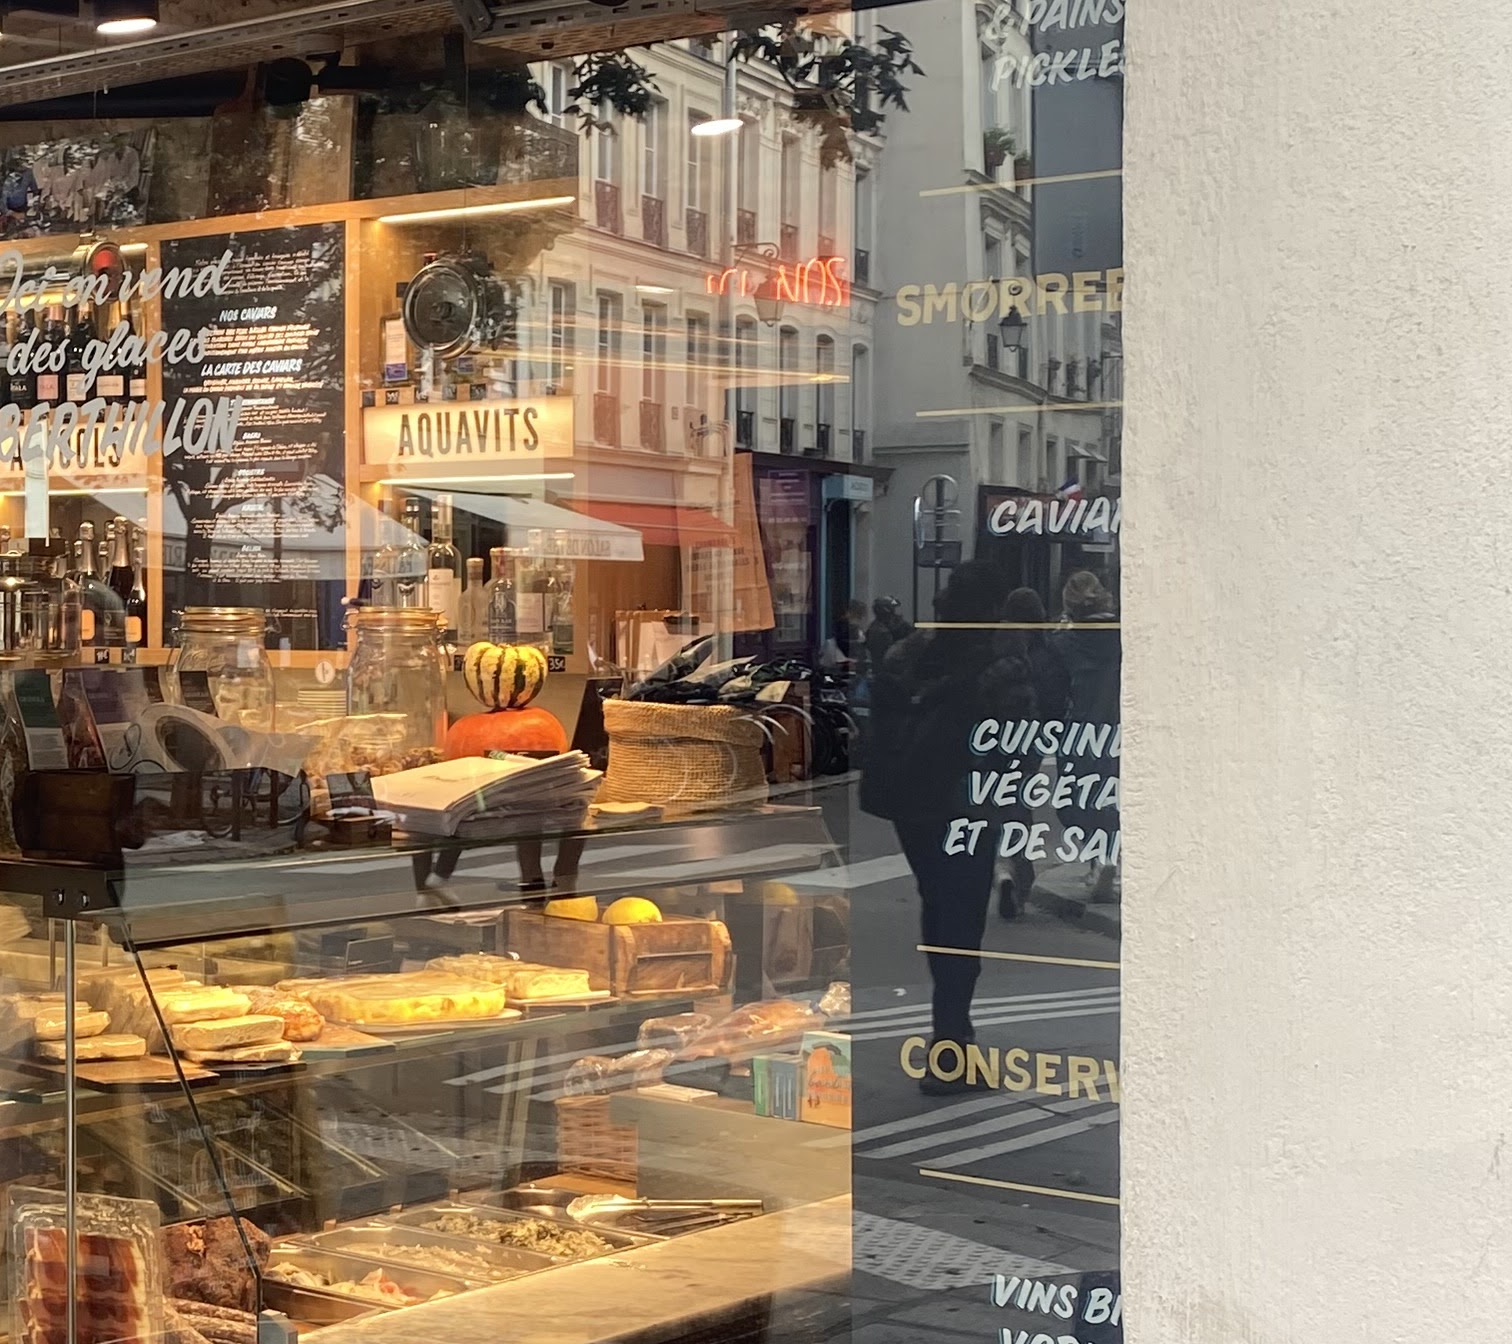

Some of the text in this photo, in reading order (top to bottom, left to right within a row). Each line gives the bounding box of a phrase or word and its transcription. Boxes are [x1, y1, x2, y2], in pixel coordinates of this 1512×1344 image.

[63, 270, 112, 309] on
[118, 249, 234, 304] vend
[219, 306, 278, 322] NOS CAVIARS
[6, 327, 71, 376] des
[76, 320, 214, 396] glaces
[200, 358, 304, 377] LA CARTE DES CAVIARS
[398, 407, 539, 458] AQUAVITS
[969, 759, 1120, 811] VÉGÉTA
[944, 817, 987, 856] ET
[998, 821, 1050, 859] DE
[992, 1274, 1078, 1319] VINS
